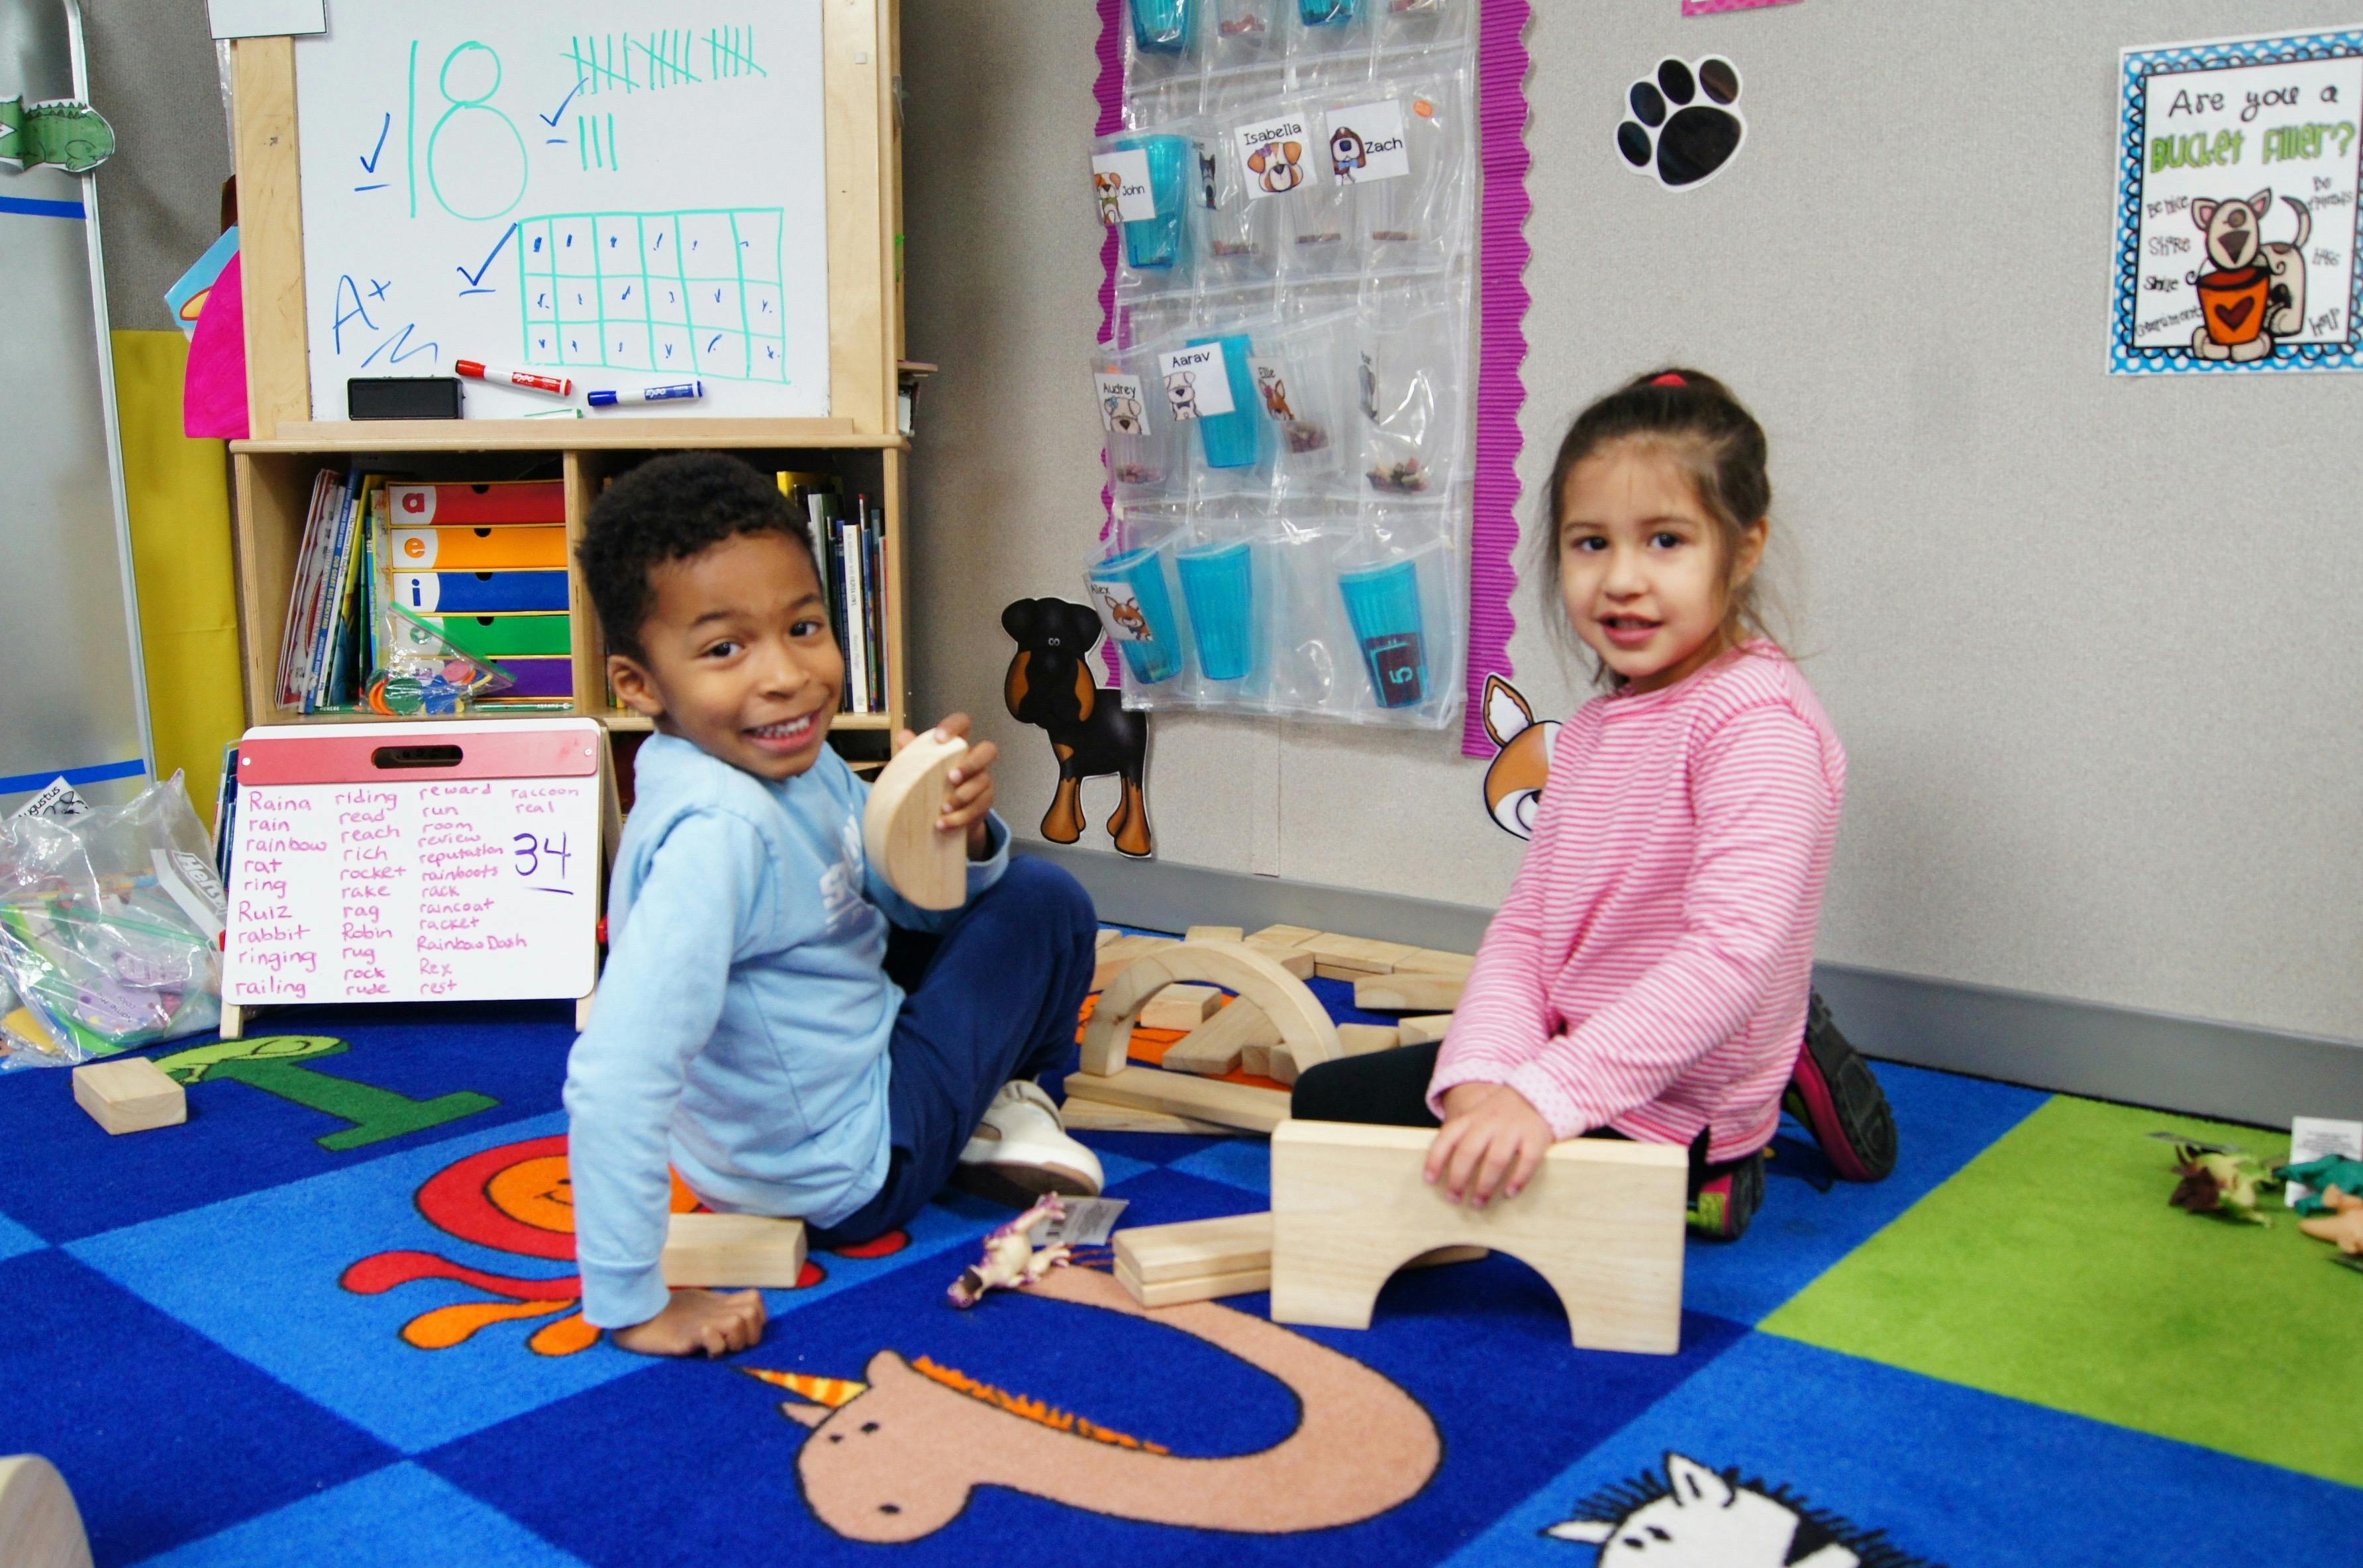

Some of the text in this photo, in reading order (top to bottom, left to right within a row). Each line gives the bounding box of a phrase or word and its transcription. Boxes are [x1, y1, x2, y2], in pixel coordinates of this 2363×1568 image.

[2168, 84, 2340, 122] Are you a
[409, 40, 528, 221] 18
[1244, 122, 1302, 145] Isabella
[1365, 138, 1403, 154] Zach
[1122, 185, 1145, 197] John
[332, 273, 391, 354] A+
[1172, 352, 1211, 368] Aarav
[1103, 383, 1136, 397] Audrey
[402, 493, 425, 513] a
[405, 538, 425, 559] e
[411, 579, 421, 607] i
[336, 789, 398, 809] riding
[420, 783, 492, 799] reward
[511, 787, 579, 797] raccoon
[18, 786, 60, 817] ugustus
[249, 791, 313, 811] Raina
[516, 801, 554, 813] real
[339, 810, 385, 824] read
[423, 805, 458, 817] run
[249, 818, 290, 832] rain
[423, 821, 474, 832] room
[342, 826, 400, 841] reach
[419, 834, 481, 847] review
[246, 838, 327, 852] rainbow
[344, 848, 388, 860] rich
[513, 832, 572, 879] 34
[244, 858, 282, 873] rat
[340, 867, 406, 880] rocket
[244, 879, 287, 899] ring
[342, 885, 391, 898] rake
[423, 886, 460, 897] rack
[238, 901, 291, 920] Ruiz
[343, 906, 380, 922] rag
[421, 899, 494, 914] raincoat
[342, 923, 393, 940] Robin
[420, 917, 479, 930] racket
[238, 926, 311, 942] rabbit
[487, 935, 527, 950] Dash
[239, 950, 318, 972] ringing
[342, 948, 376, 965] rug
[344, 967, 385, 980] rock
[420, 958, 452, 975] Rex
[236, 977, 307, 999] railing
[346, 983, 389, 995] rude
[421, 980, 457, 995] rest
